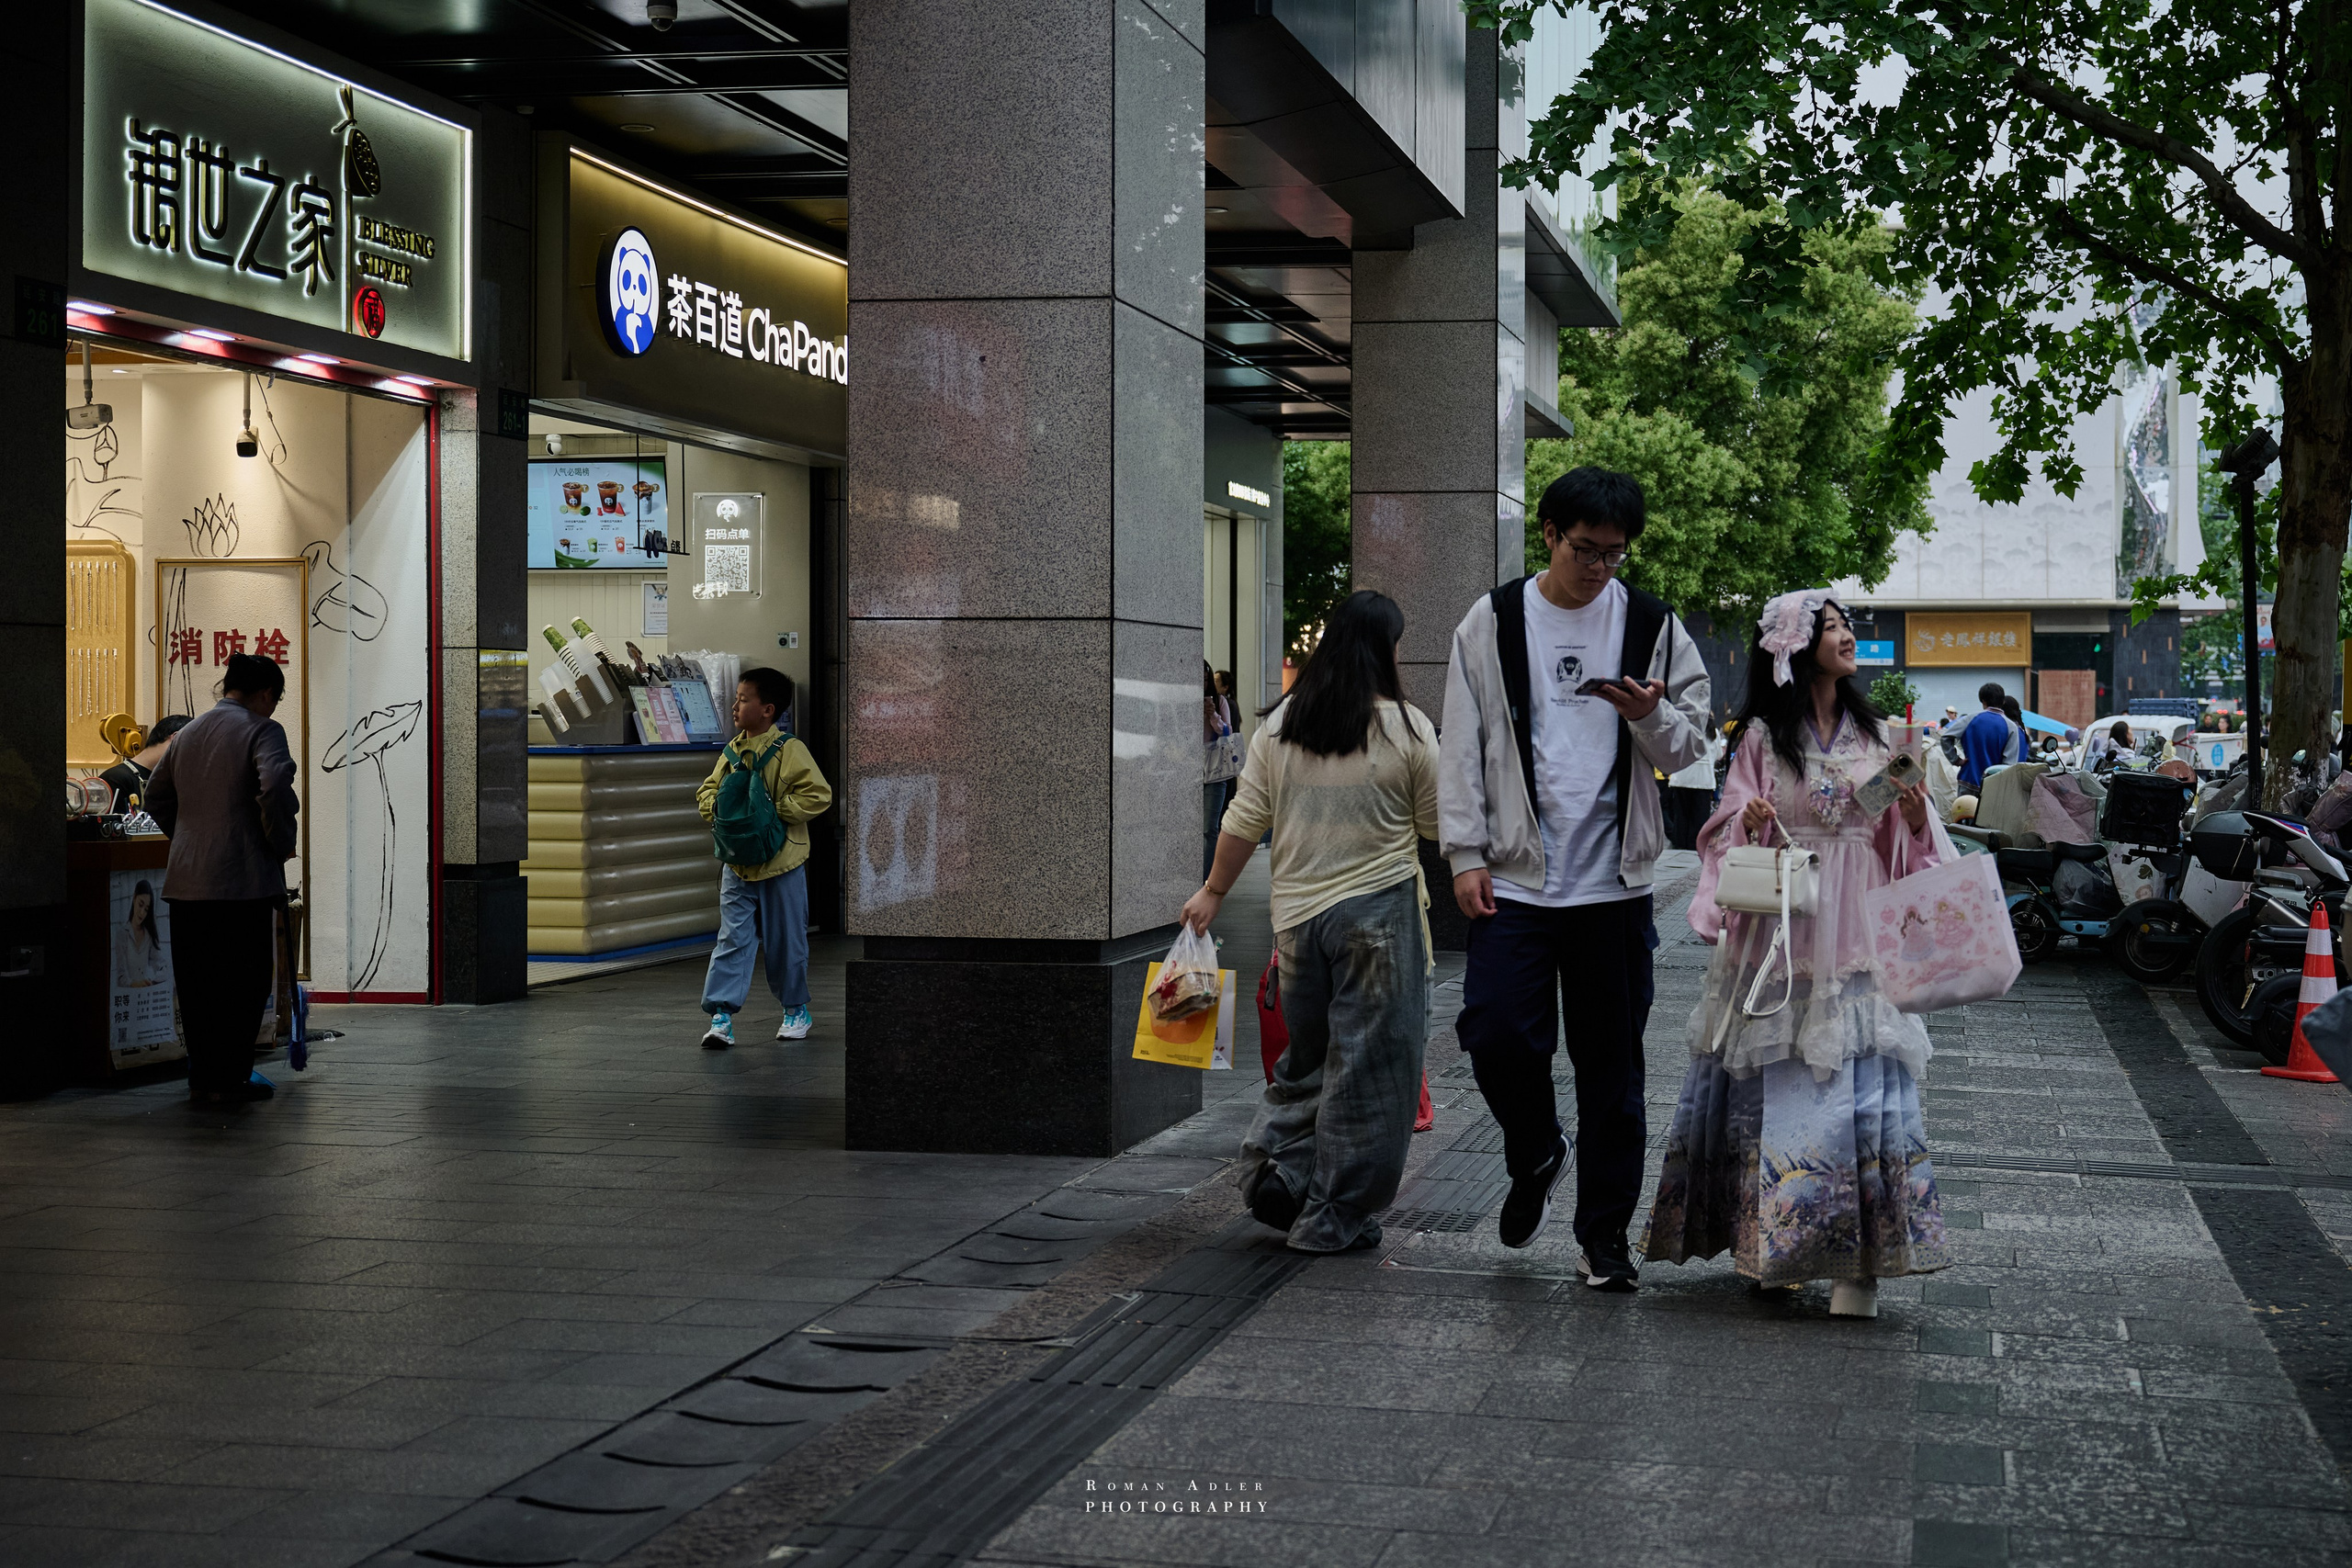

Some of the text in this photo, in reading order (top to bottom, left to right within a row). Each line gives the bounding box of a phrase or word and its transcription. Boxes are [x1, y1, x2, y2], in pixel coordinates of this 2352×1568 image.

[357, 215, 436, 260] BLESSING
[356, 250, 414, 288] SILVER
[27, 308, 59, 339] 261
[667, 273, 743, 359] 茶百道
[503, 411, 526, 434] 261-1
[553, 467, 590, 478] 人气必喝榜
[705, 528, 750, 540] 扫码点单
[168, 626, 291, 667] 消防栓
[114, 995, 130, 1008] 职等
[114, 1010, 130, 1023] 你来
